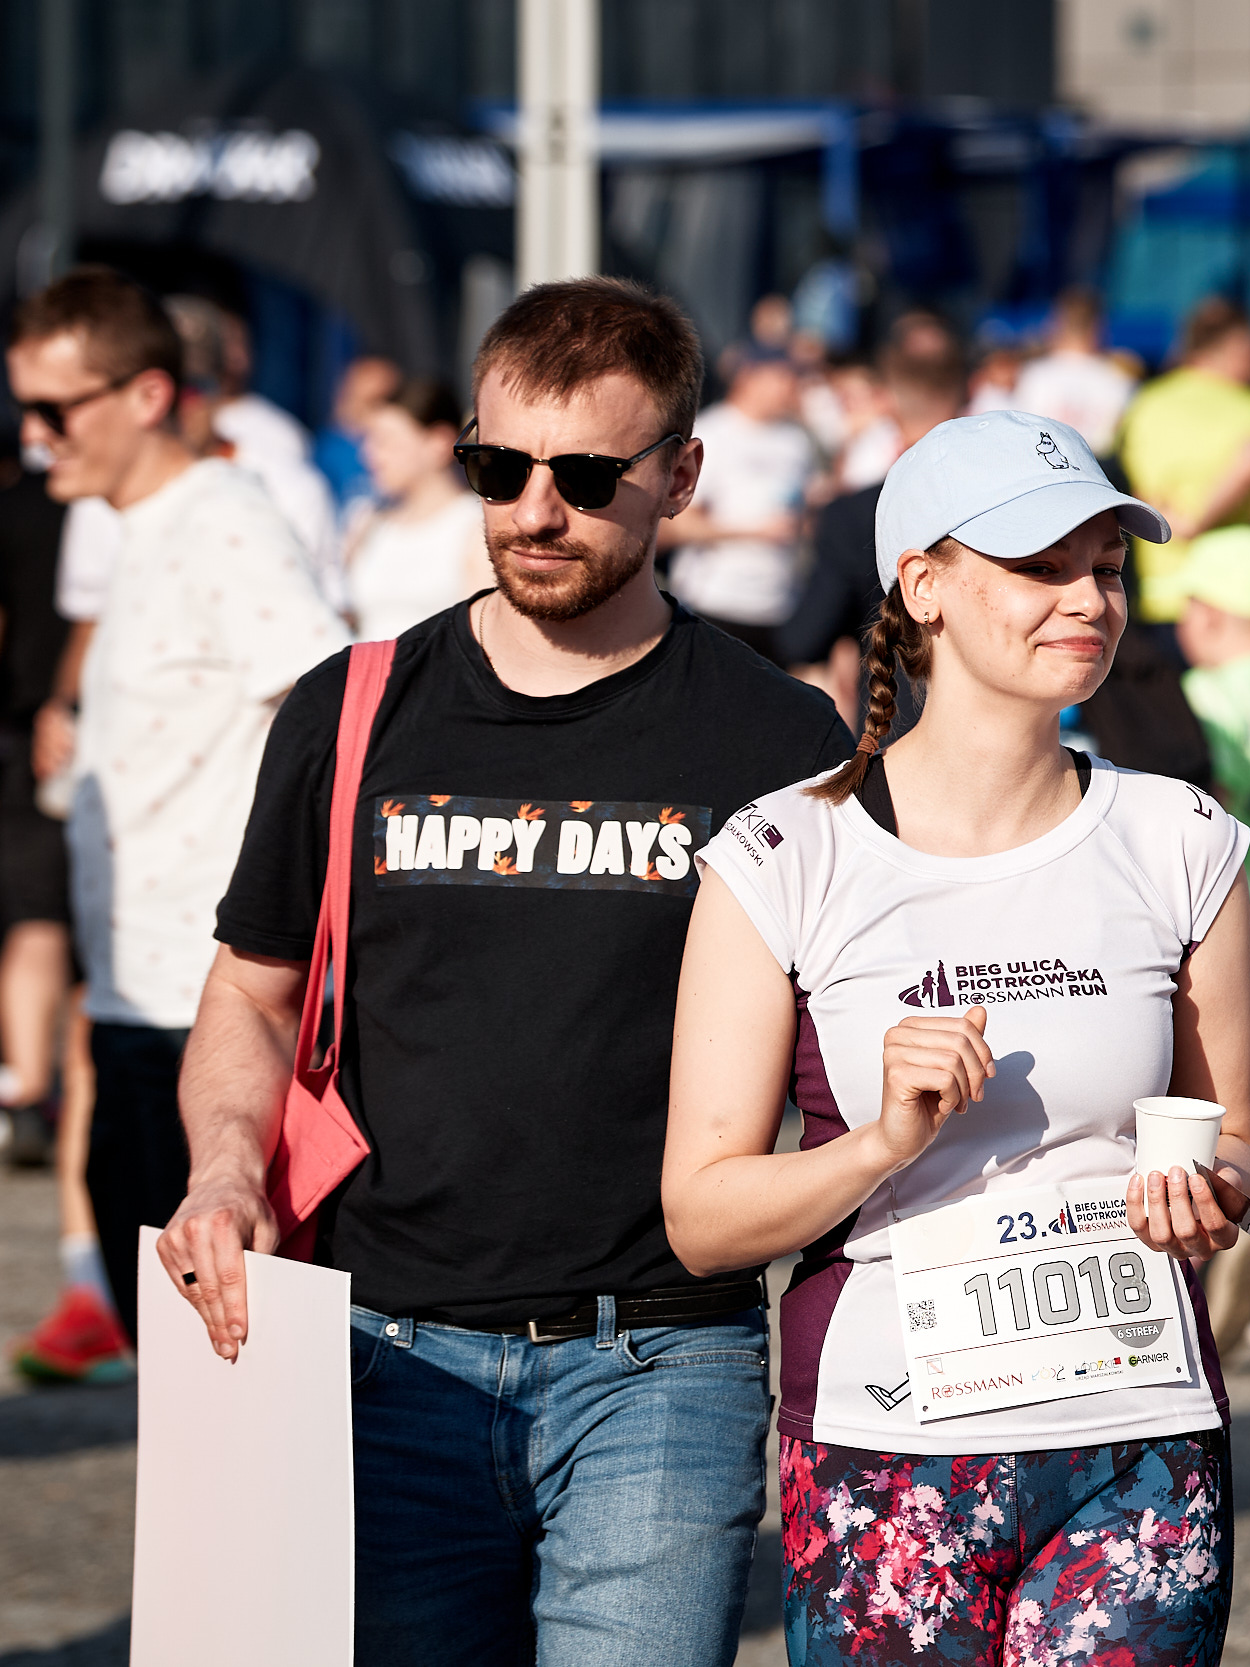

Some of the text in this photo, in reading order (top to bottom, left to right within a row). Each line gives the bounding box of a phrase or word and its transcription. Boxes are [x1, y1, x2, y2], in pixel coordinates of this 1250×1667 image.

[385, 814, 693, 881] HAPPY DAYS
[955, 963, 1001, 977] BIEG
[959, 984, 1108, 1005] ROSSMANN RUN
[1074, 1202, 1097, 1213] BIEG
[1076, 1209, 1127, 1223] PIOTRKOW
[996, 1211, 1047, 1244] 23.
[963, 1251, 1152, 1336] 11018
[1117, 1325, 1160, 1339] 6 STREFA
[931, 1372, 1024, 1400] ROSSMANN
